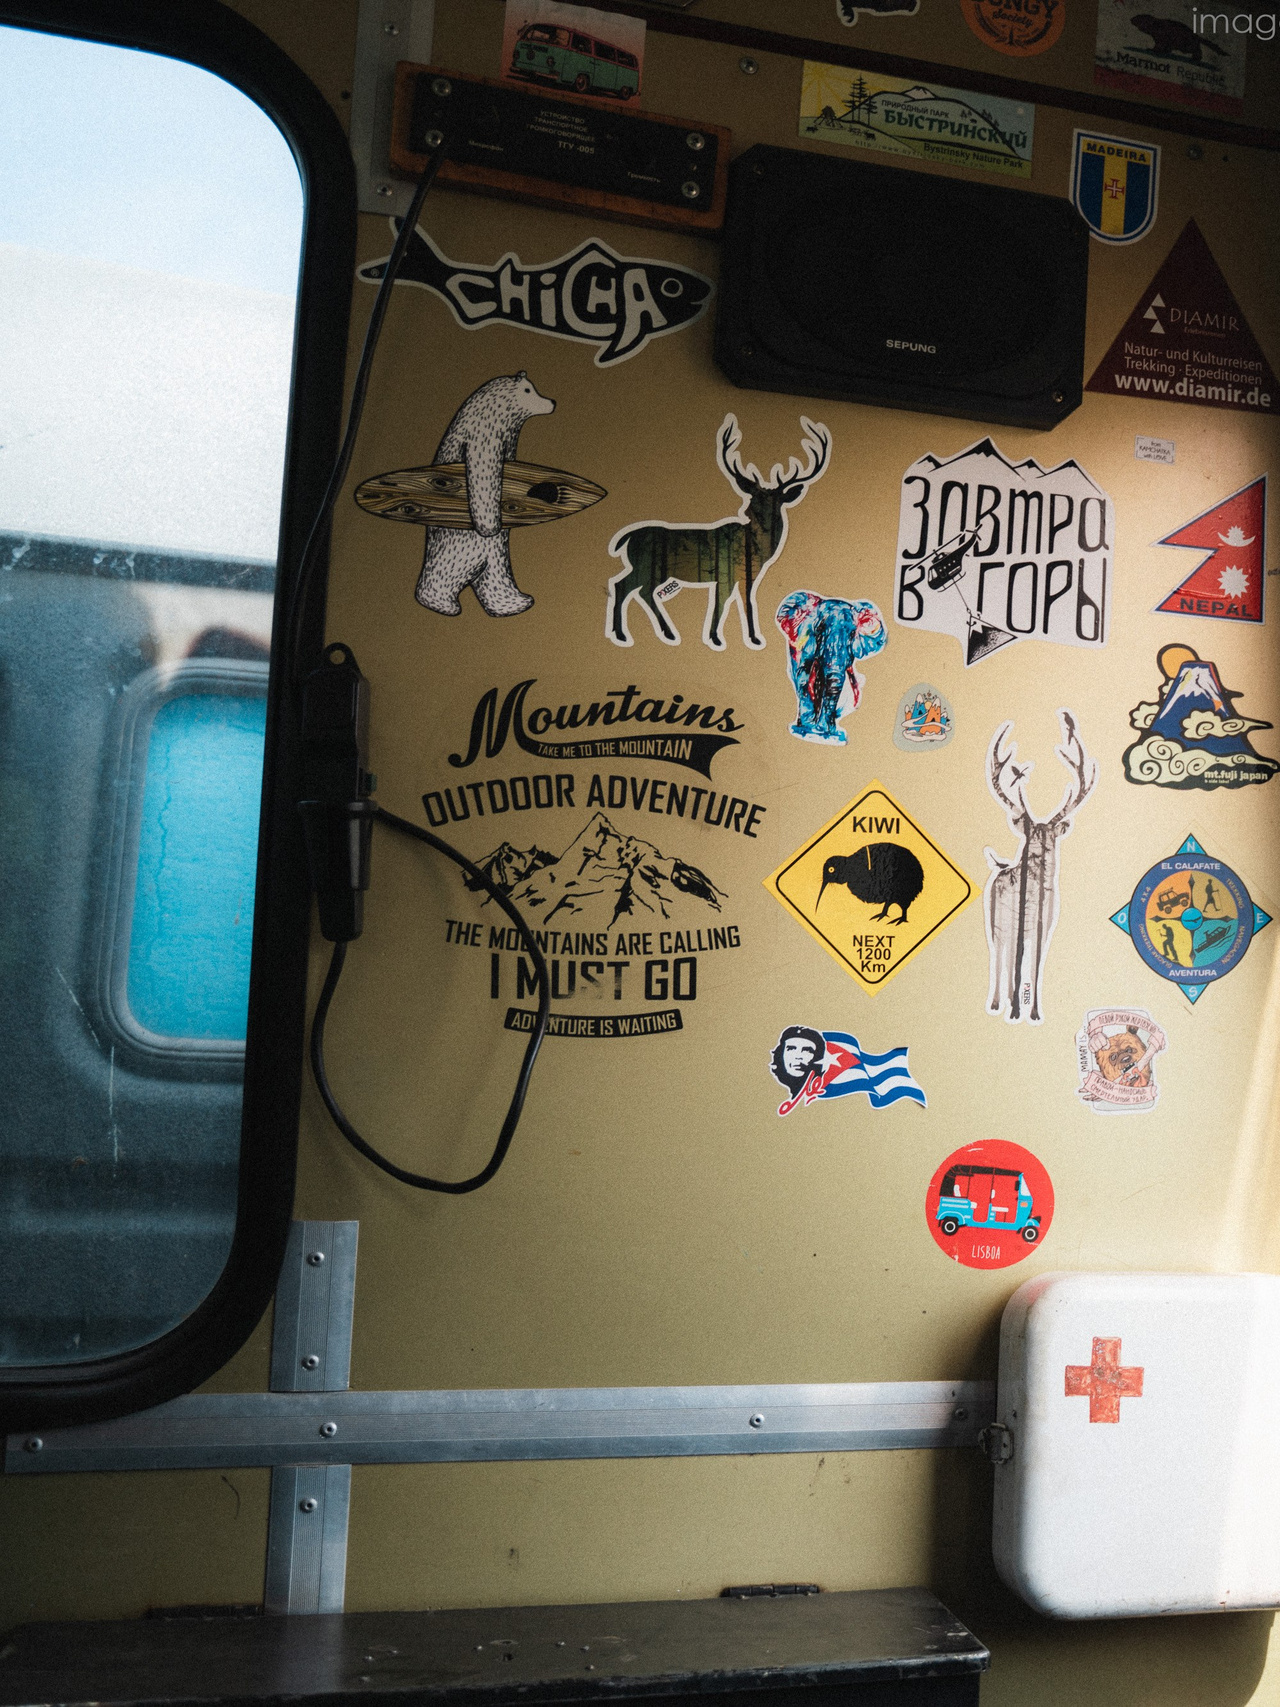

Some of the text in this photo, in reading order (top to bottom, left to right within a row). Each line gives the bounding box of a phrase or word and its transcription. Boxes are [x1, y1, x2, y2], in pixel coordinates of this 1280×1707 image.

[1117, 52, 1171, 74] Marmot
[881, 99, 949, 119] ПРИРОДНЫЙ ПАРК
[884, 109, 1028, 149] БЫСТРИНСКИЙ
[924, 143, 1023, 169] Bystrinsky Nature Park
[1086, 143, 1147, 162] MADEIRA
[1170, 308, 1240, 332] DIAMIR
[886, 339, 937, 354] SEPUNG
[1125, 342, 1263, 371] Natur- und Kulturreisen
[1125, 357, 1262, 385] Trekking Expeditionen
[1114, 374, 1271, 407] www.diamir.de
[898, 558, 1108, 643] В ГОРЫ
[1180, 598, 1253, 617] NEPAL
[447, 678, 746, 768] Mountains
[537, 739, 694, 760] TAKE ME TO THE MOUNTAIN
[1240, 770, 1269, 782] japan
[422, 774, 767, 838] OUTDOOR ADVENTURE
[853, 816, 900, 834] KIWI
[1186, 841, 1196, 852] N
[1161, 862, 1221, 870] EL CALAFATE
[445, 919, 484, 946] THE
[615, 933, 653, 956] ARE
[660, 926, 741, 955] CALLING
[853, 935, 896, 948] NEXT
[857, 948, 891, 960] 1200
[861, 960, 886, 972] Km
[1169, 969, 1218, 977] AVENTURA
[491, 953, 697, 1001] I MUST GO
[1189, 986, 1198, 998] S
[511, 1012, 677, 1036] ADNTURE IS WAITING
[971, 1245, 1001, 1260] LISBOA
